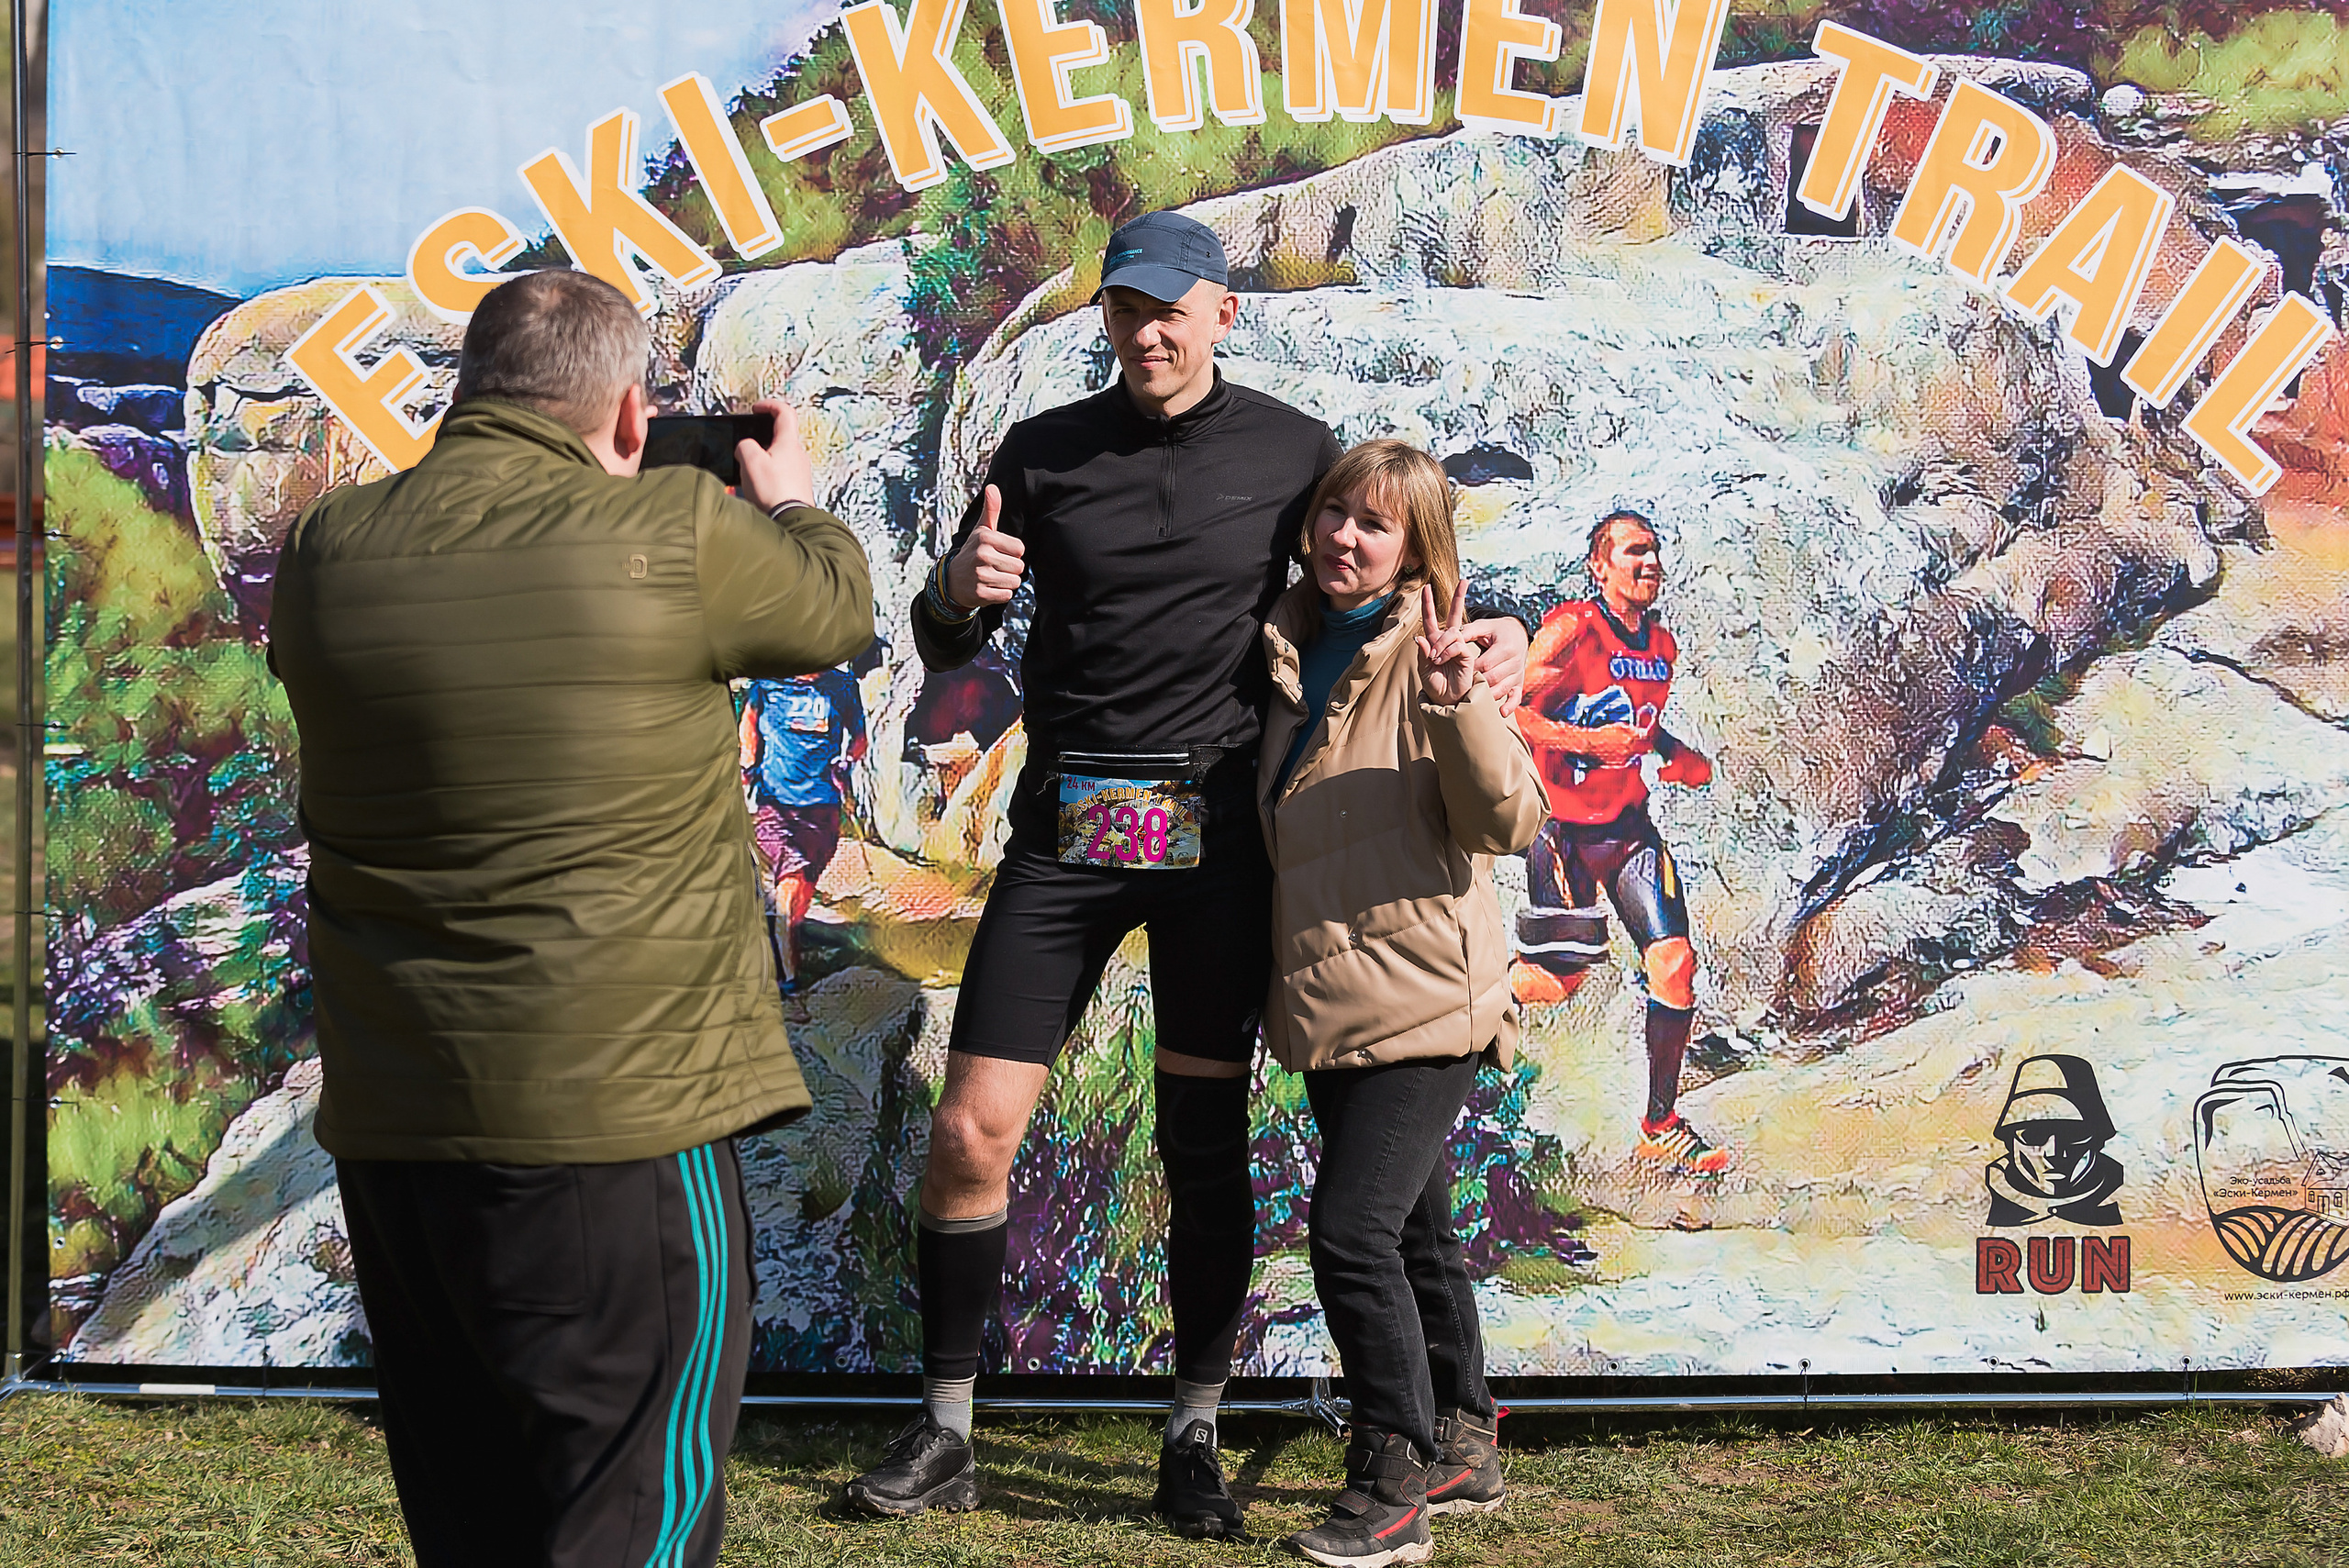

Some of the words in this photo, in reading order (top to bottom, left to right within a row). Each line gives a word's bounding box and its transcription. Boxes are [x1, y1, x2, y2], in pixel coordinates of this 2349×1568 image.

[285, 0, 1731, 473] ESKI-KERMEN
[1812, 20, 2336, 496] TRAIL
[1066, 776, 1078, 789] 24
[1081, 781, 1096, 791] KM
[1071, 786, 1152, 816] ESKI-KERMEN
[1155, 793, 1187, 820] TRAIL
[1087, 804, 1168, 862] 238
[2230, 1175, 2291, 1186] Эко-усадьба
[2213, 1188, 2299, 1198] «Эски-Кермен»
[1976, 1236, 2131, 1295] RUN
[2223, 1288, 2349, 1301] www.эски-кермен.рф
